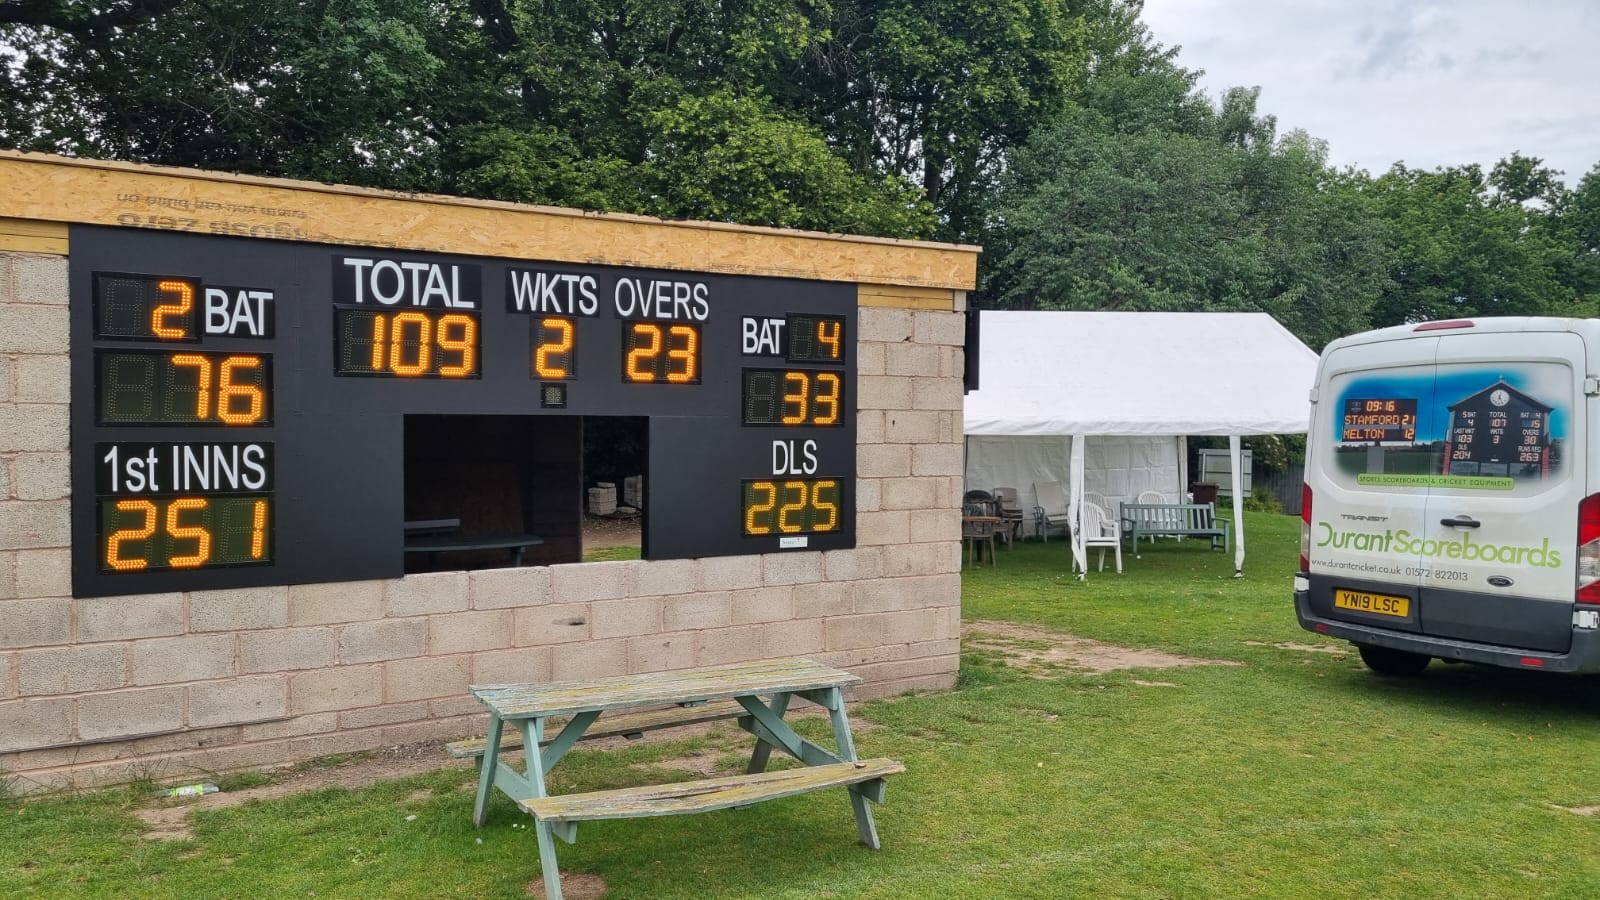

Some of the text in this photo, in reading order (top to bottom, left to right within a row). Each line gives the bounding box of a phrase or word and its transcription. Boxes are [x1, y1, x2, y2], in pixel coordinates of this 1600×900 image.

[344, 258, 475, 309] TOTAL
[511, 271, 598, 315] WKTS
[615, 278, 709, 321] OVERS
[152, 281, 192, 338] 2
[205, 288, 273, 336] BAT
[371, 312, 476, 377] 109
[535, 318, 574, 379] 2
[626, 324, 697, 382] 23
[743, 318, 786, 354] BAT
[818, 321, 841, 358] 4
[171, 355, 263, 424] 76
[782, 372, 840, 425] 33
[1344, 414, 1400, 425] STAMFORD
[1489, 411, 1507, 419] TOTAL
[1491, 418, 1507, 428] 107
[1343, 428, 1415, 440] MELTON 12
[1457, 434, 1472, 443] 103
[1493, 435, 1500, 444] 3
[1523, 435, 1537, 445] 30
[104, 444, 266, 492] 1st INNS
[773, 440, 817, 475] DLS
[1452, 450, 1471, 460] 204
[1519, 452, 1539, 462] 263
[1383, 476, 1428, 484] SCOREBOARDS
[1438, 478, 1467, 486] CRICKET
[1470, 479, 1511, 487] EQUIPMENT
[746, 481, 836, 535] 225
[1341, 514, 1388, 522] TRANSIT
[107, 498, 268, 571] 251
[1311, 558, 1469, 582] www.durantcricket.co.uk 01572 822013
[1343, 592, 1400, 613] YN19 LSC
